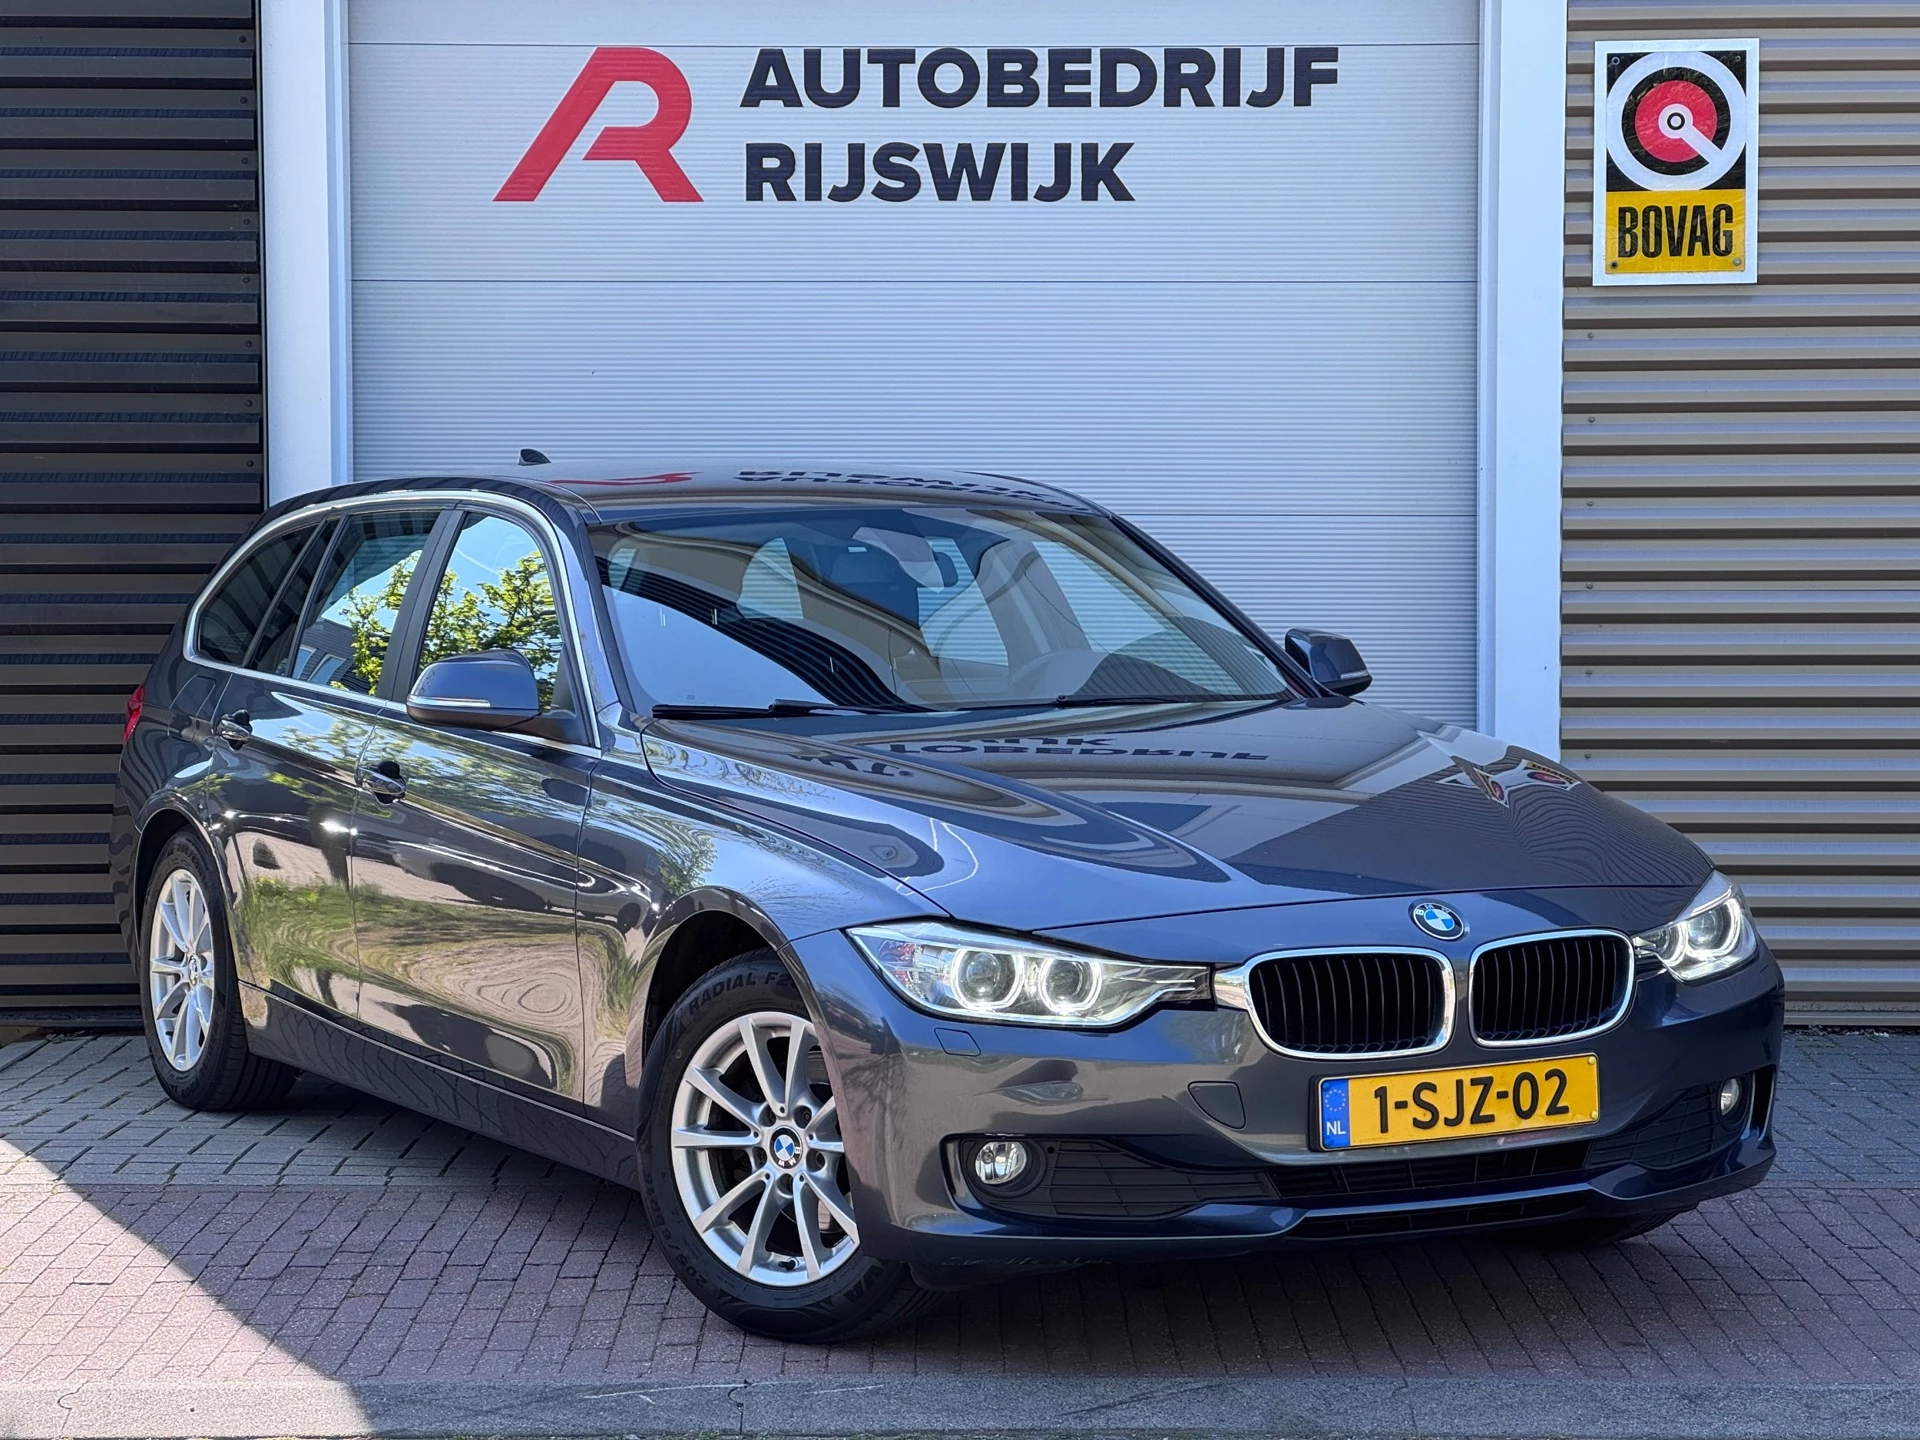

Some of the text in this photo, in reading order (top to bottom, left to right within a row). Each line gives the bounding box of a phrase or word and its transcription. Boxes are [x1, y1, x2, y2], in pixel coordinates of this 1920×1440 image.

[739, 46, 1339, 109] AUTOBEDRIJF
[744, 141, 1135, 203] RIJSWIJK
[1617, 203, 1734, 258] BOVAG
[688, 971, 797, 1015] RADIAL F2
[1326, 1120, 1346, 1136] NL
[1373, 1068, 1570, 1134] 1-SJZ-02
[777, 1146, 802, 1167] BMW
